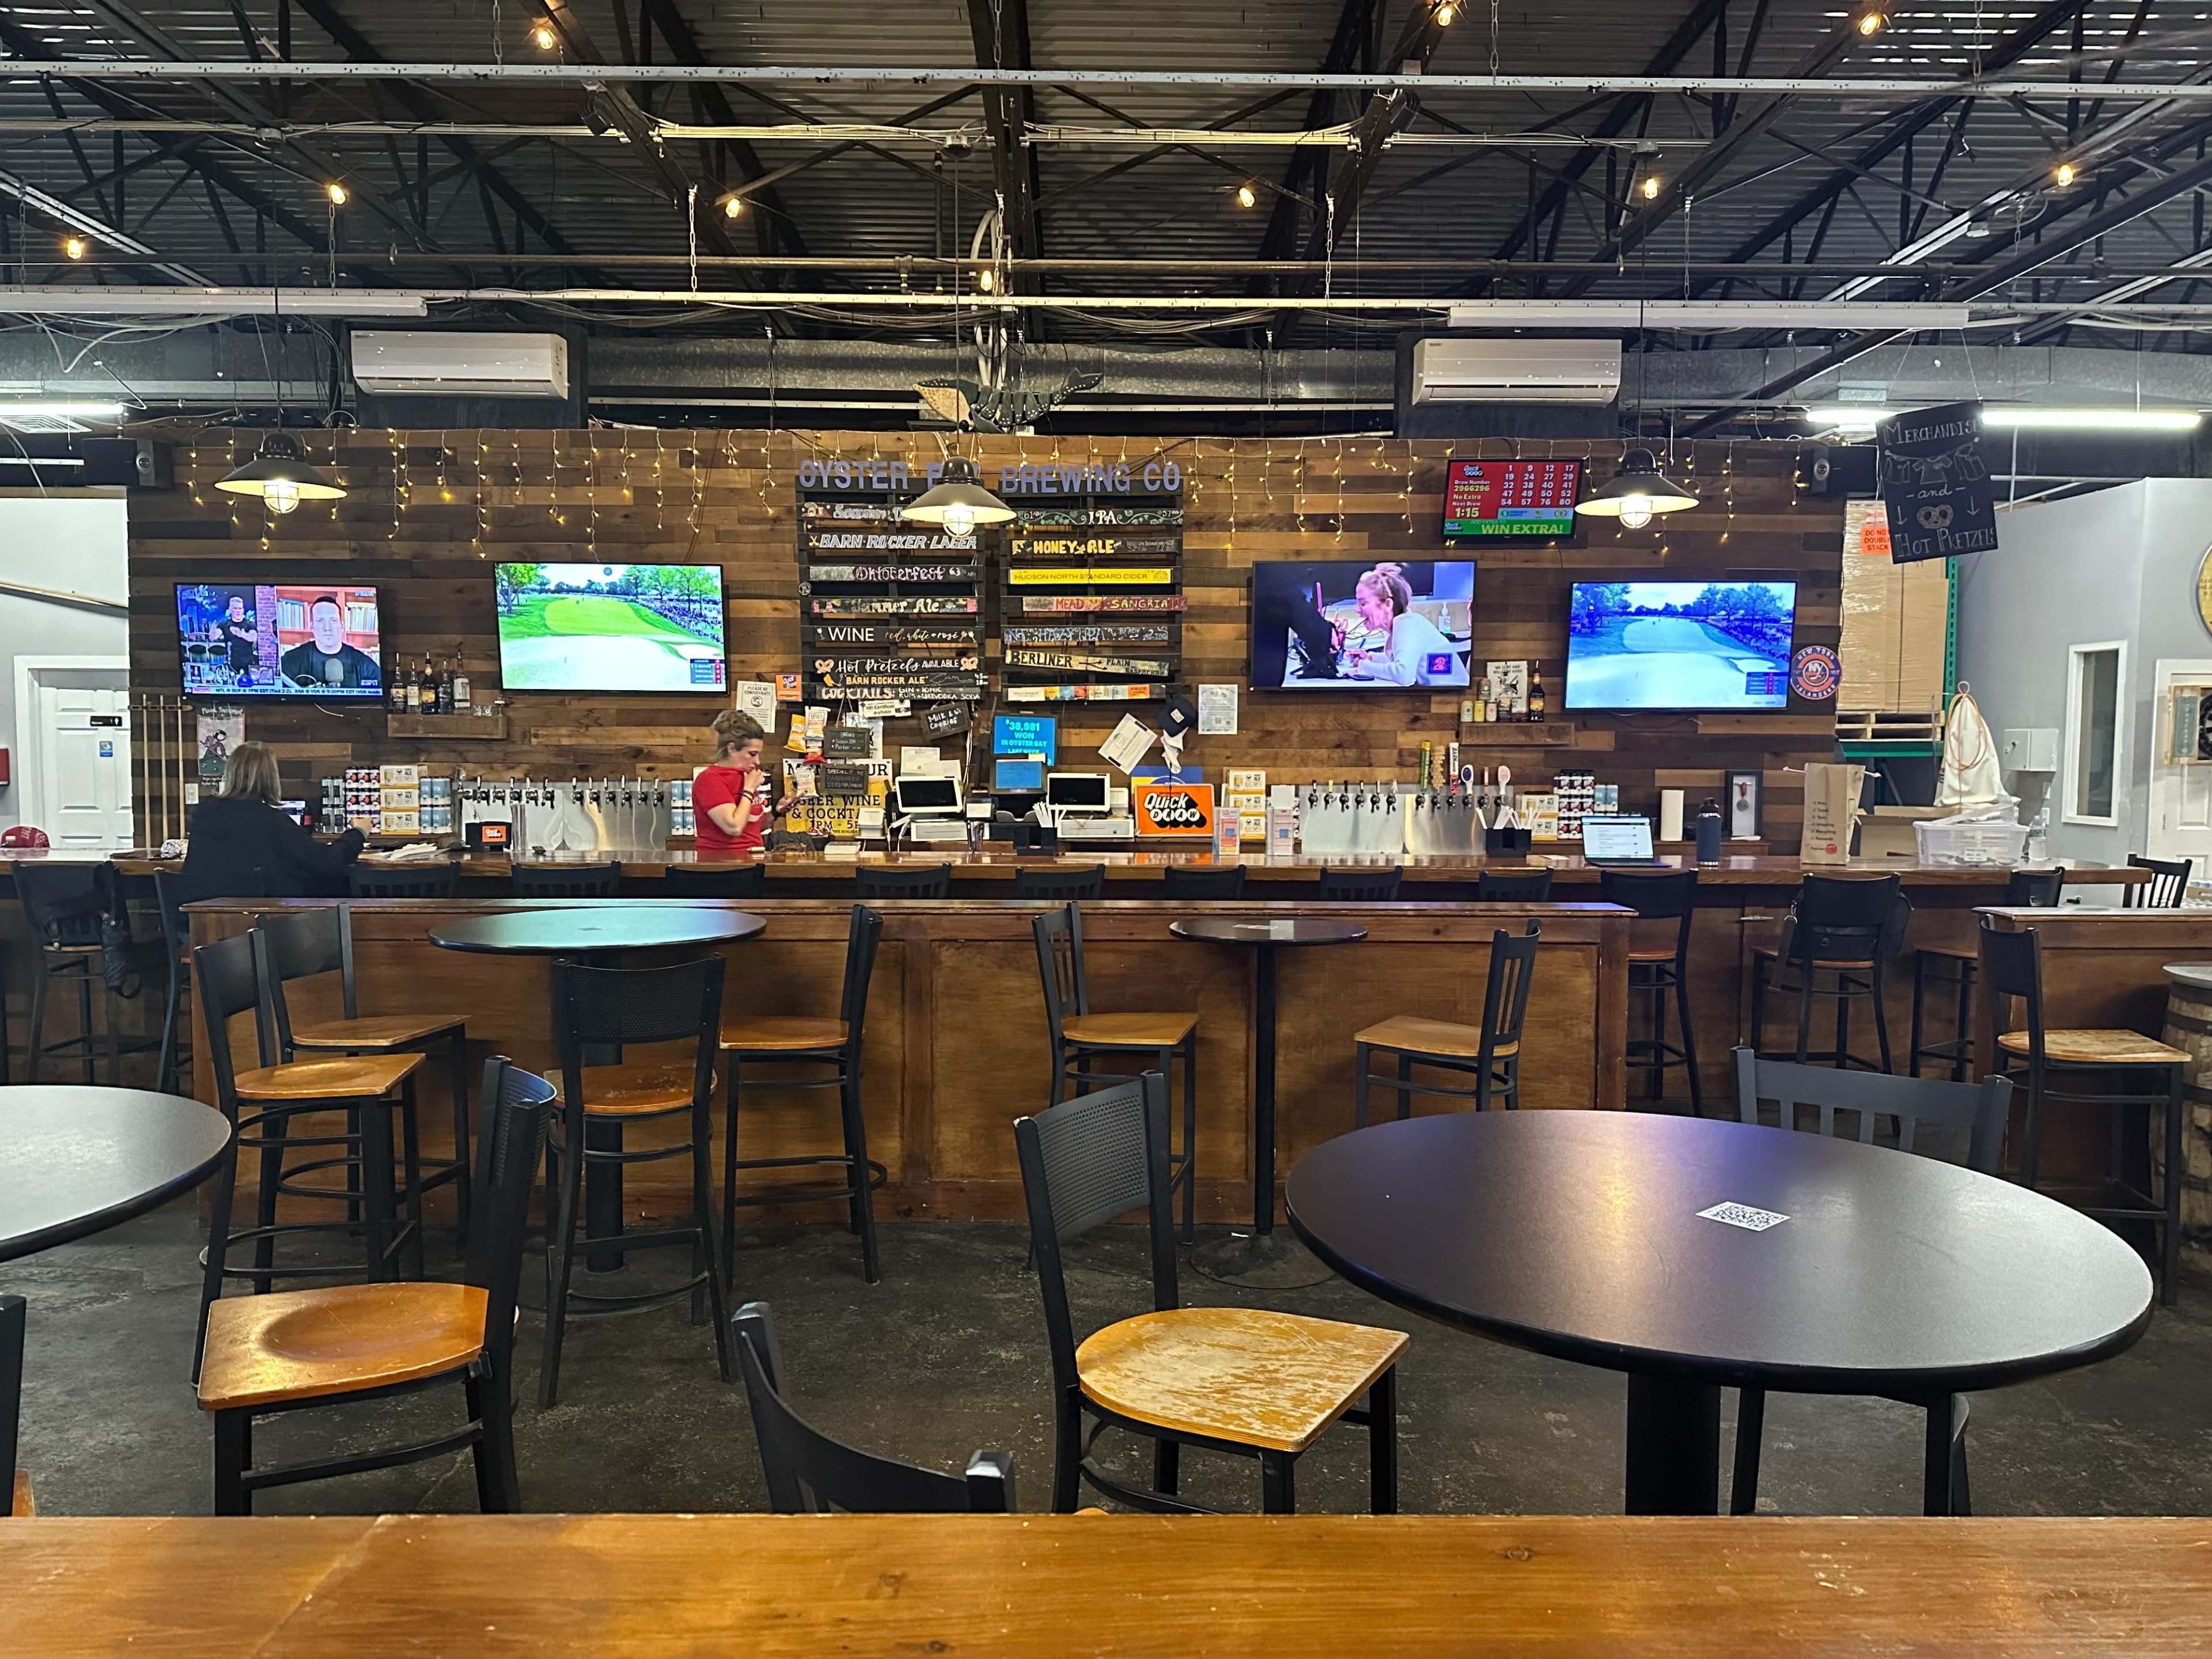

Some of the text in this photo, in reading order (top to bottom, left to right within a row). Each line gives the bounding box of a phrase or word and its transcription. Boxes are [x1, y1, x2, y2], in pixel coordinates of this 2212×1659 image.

[799, 460, 908, 489] OYSTER
[1002, 464, 1131, 493] BREWING
[1143, 463, 1180, 491] CO
[1088, 511, 1116, 524] IPA
[1455, 508, 1479, 517] 1:15
[1482, 524, 1563, 534] WIN EXTRA!
[820, 534, 978, 548] BARN ROCKER LAGER
[1033, 540, 1077, 554] HONEY
[1087, 540, 1115, 554] ALE
[1895, 533, 1931, 558] HOT
[856, 566, 945, 581] Oktoberfest
[913, 599, 940, 612] Ale
[1055, 598, 1085, 609] MEAD
[1111, 599, 1168, 609] SANGRIA
[828, 627, 874, 642] WINE
[907, 628, 930, 641] white
[1010, 652, 1073, 668] BERLINER
[1798, 648, 1835, 660] NEW YORK
[835, 658, 959, 673] Hot Pretzels AVAILABLE
[1434, 657, 1445, 671] 2
[1808, 662, 1822, 672] NY
[846, 676, 869, 685] BARN
[872, 676, 905, 685] ROCKER
[1796, 683, 1835, 697] ISLANDERS
[928, 711, 946, 722] Milk
[1006, 719, 1040, 732] $38,981
[843, 795, 880, 805] WINE
[1144, 793, 1190, 809] Quick
[792, 809, 802, 819] &
[1152, 809, 1198, 820] DRAW
[810, 820, 833, 828] 1PM
[847, 820, 859, 828] 5P
